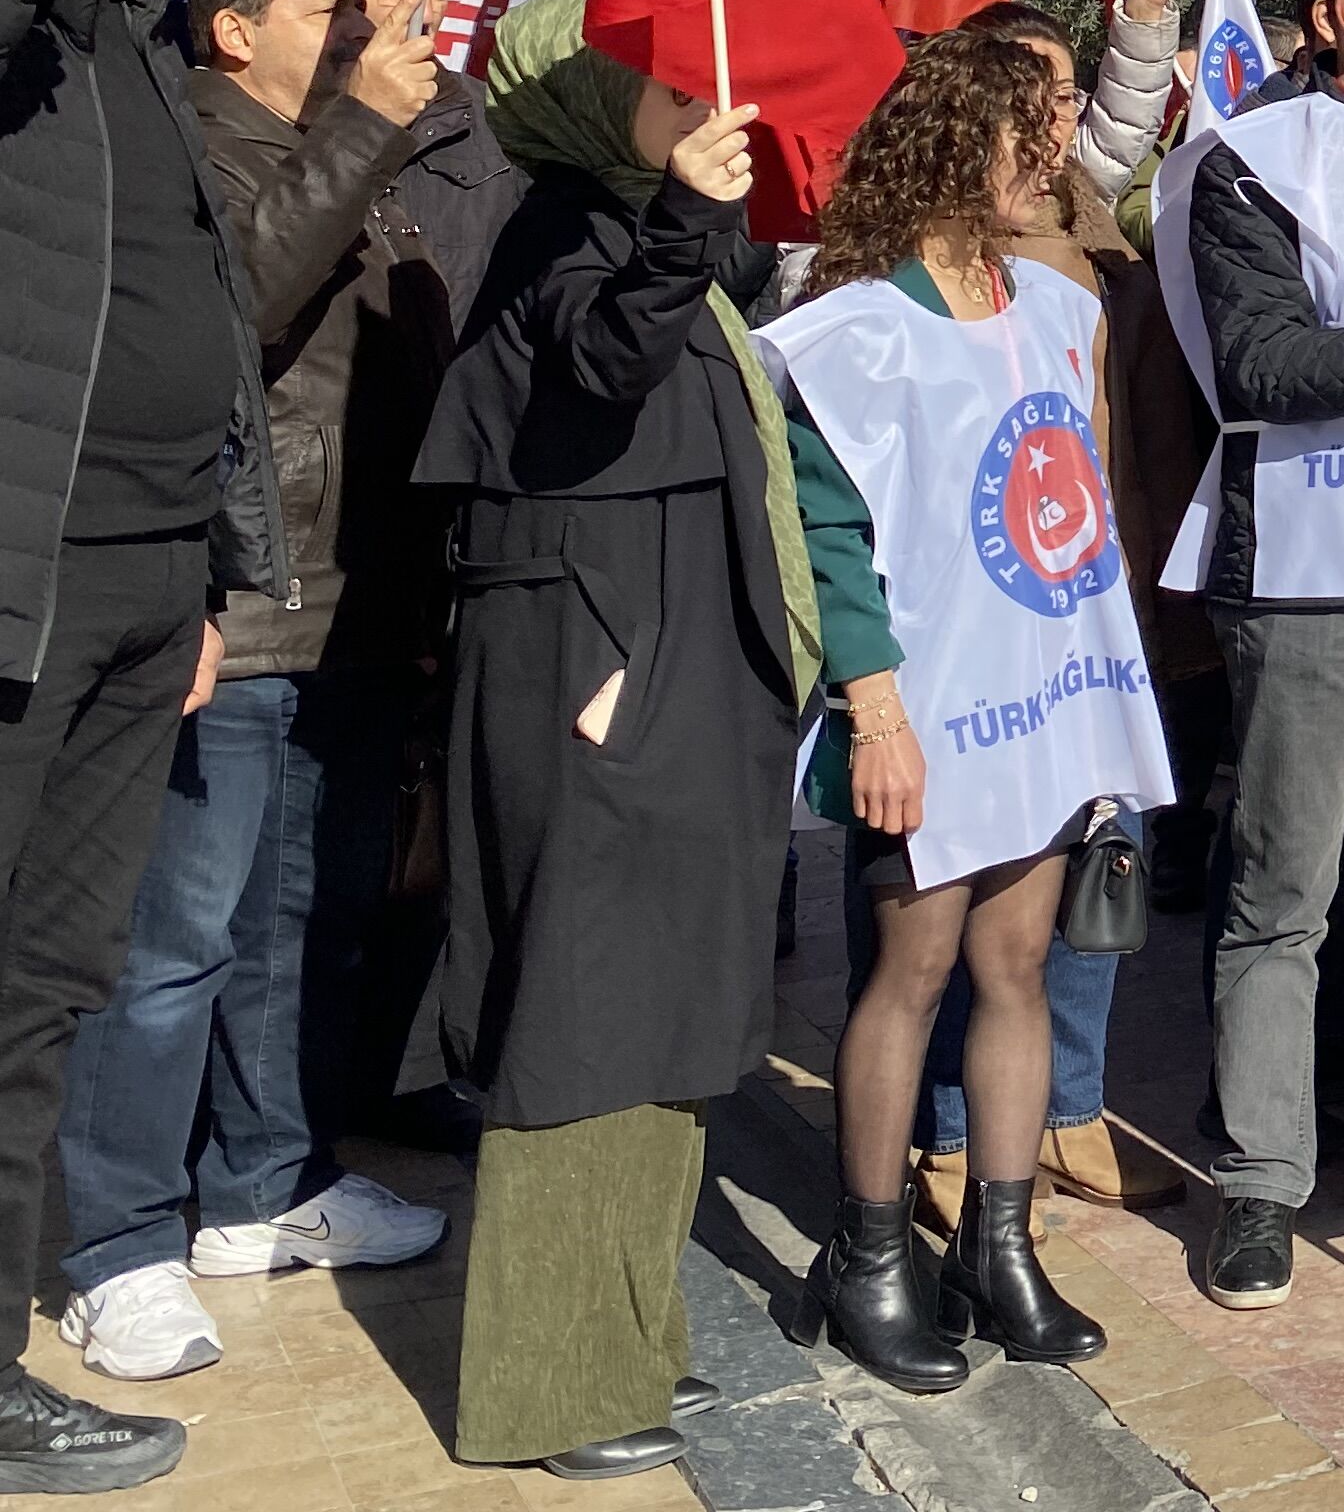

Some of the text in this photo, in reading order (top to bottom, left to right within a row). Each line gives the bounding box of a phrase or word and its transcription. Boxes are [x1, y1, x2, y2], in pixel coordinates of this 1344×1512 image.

[1208, 40, 1226, 79] 992
[980, 472, 1022, 585] TÜRK
[944, 698, 1046, 755] TÜRK
[74, 1430, 133, 1447] GORE TEX
